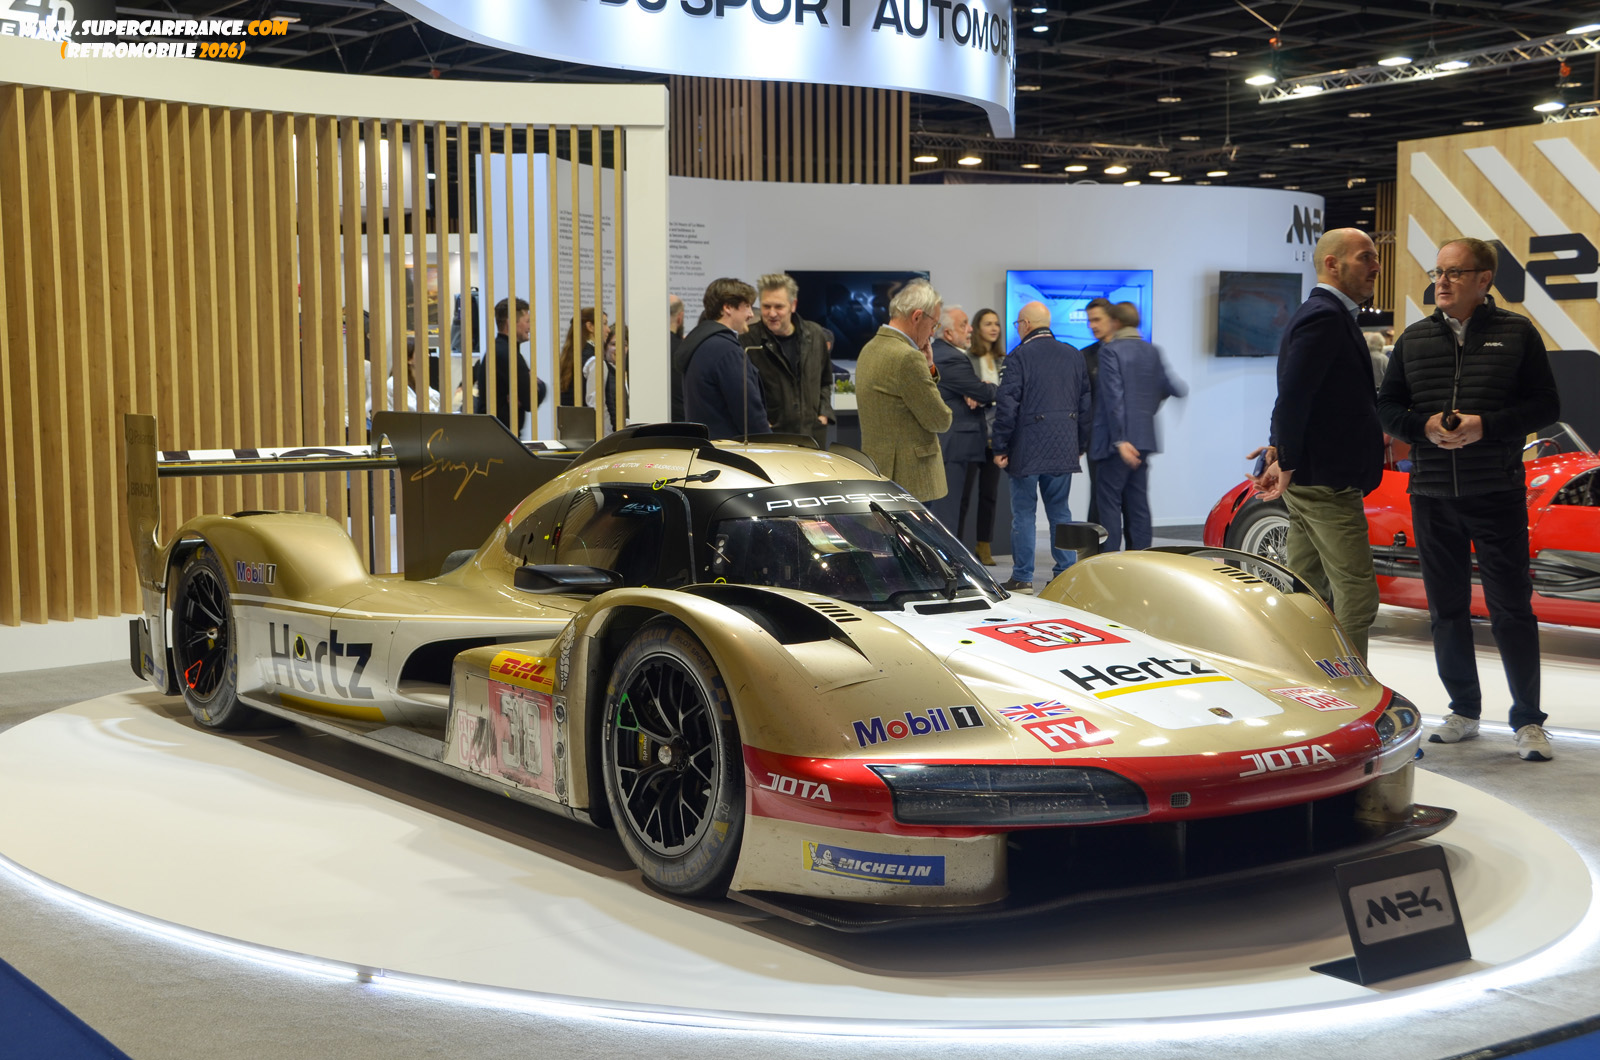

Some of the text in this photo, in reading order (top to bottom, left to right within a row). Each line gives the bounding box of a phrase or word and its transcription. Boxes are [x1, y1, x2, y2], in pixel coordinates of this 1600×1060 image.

[871, 0, 1011, 58] AUTOMOB
[766, 492, 919, 512] PORSCHE
[236, 561, 264, 584] Mobil
[994, 622, 1105, 648] 38
[269, 622, 375, 700] Hertz
[498, 657, 547, 684] DHL
[1059, 656, 1220, 691] Hertz
[1315, 655, 1364, 679] Mobil
[501, 691, 543, 776] 38
[852, 707, 950, 748] Mobil
[1030, 719, 1098, 748] HY
[1239, 744, 1337, 778] JOTA
[759, 772, 832, 803] JOTA
[837, 857, 932, 877] MICHELIN
